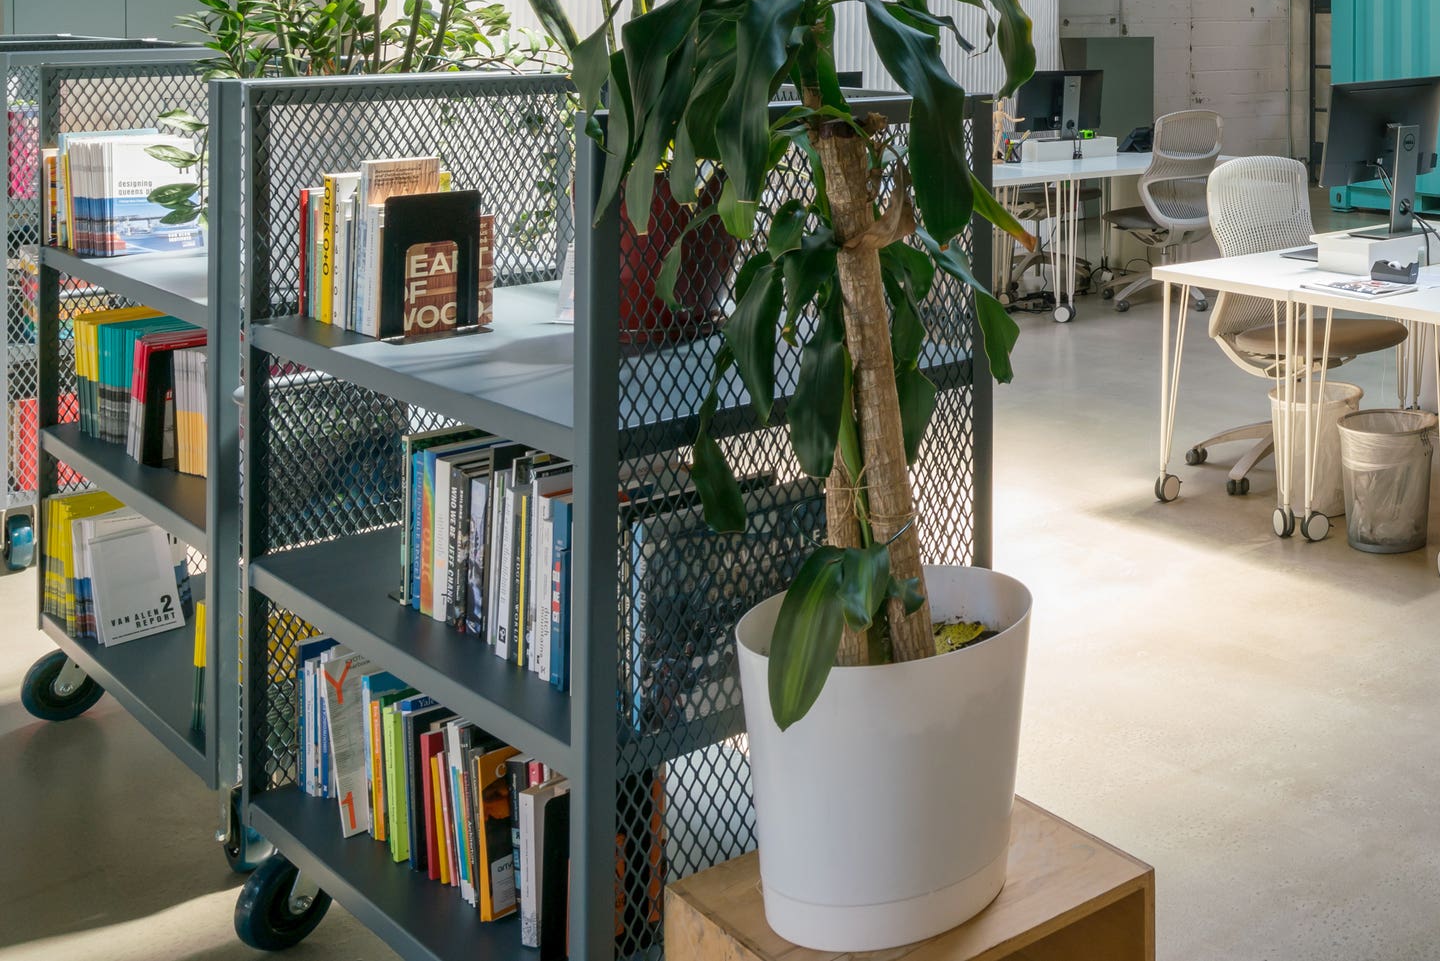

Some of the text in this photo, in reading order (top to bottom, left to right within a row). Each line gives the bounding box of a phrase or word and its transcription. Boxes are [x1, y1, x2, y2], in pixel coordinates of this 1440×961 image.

[118, 180, 152, 188] designing
[118, 188, 144, 196] queens
[450, 486, 458, 510] WHO
[450, 509, 457, 526] WE
[449, 525, 456, 539] BE
[446, 568, 454, 605] CHANG
[160, 594, 174, 613] 2
[111, 608, 159, 627] VAN ALEN
[135, 612, 175, 629] REPORT
